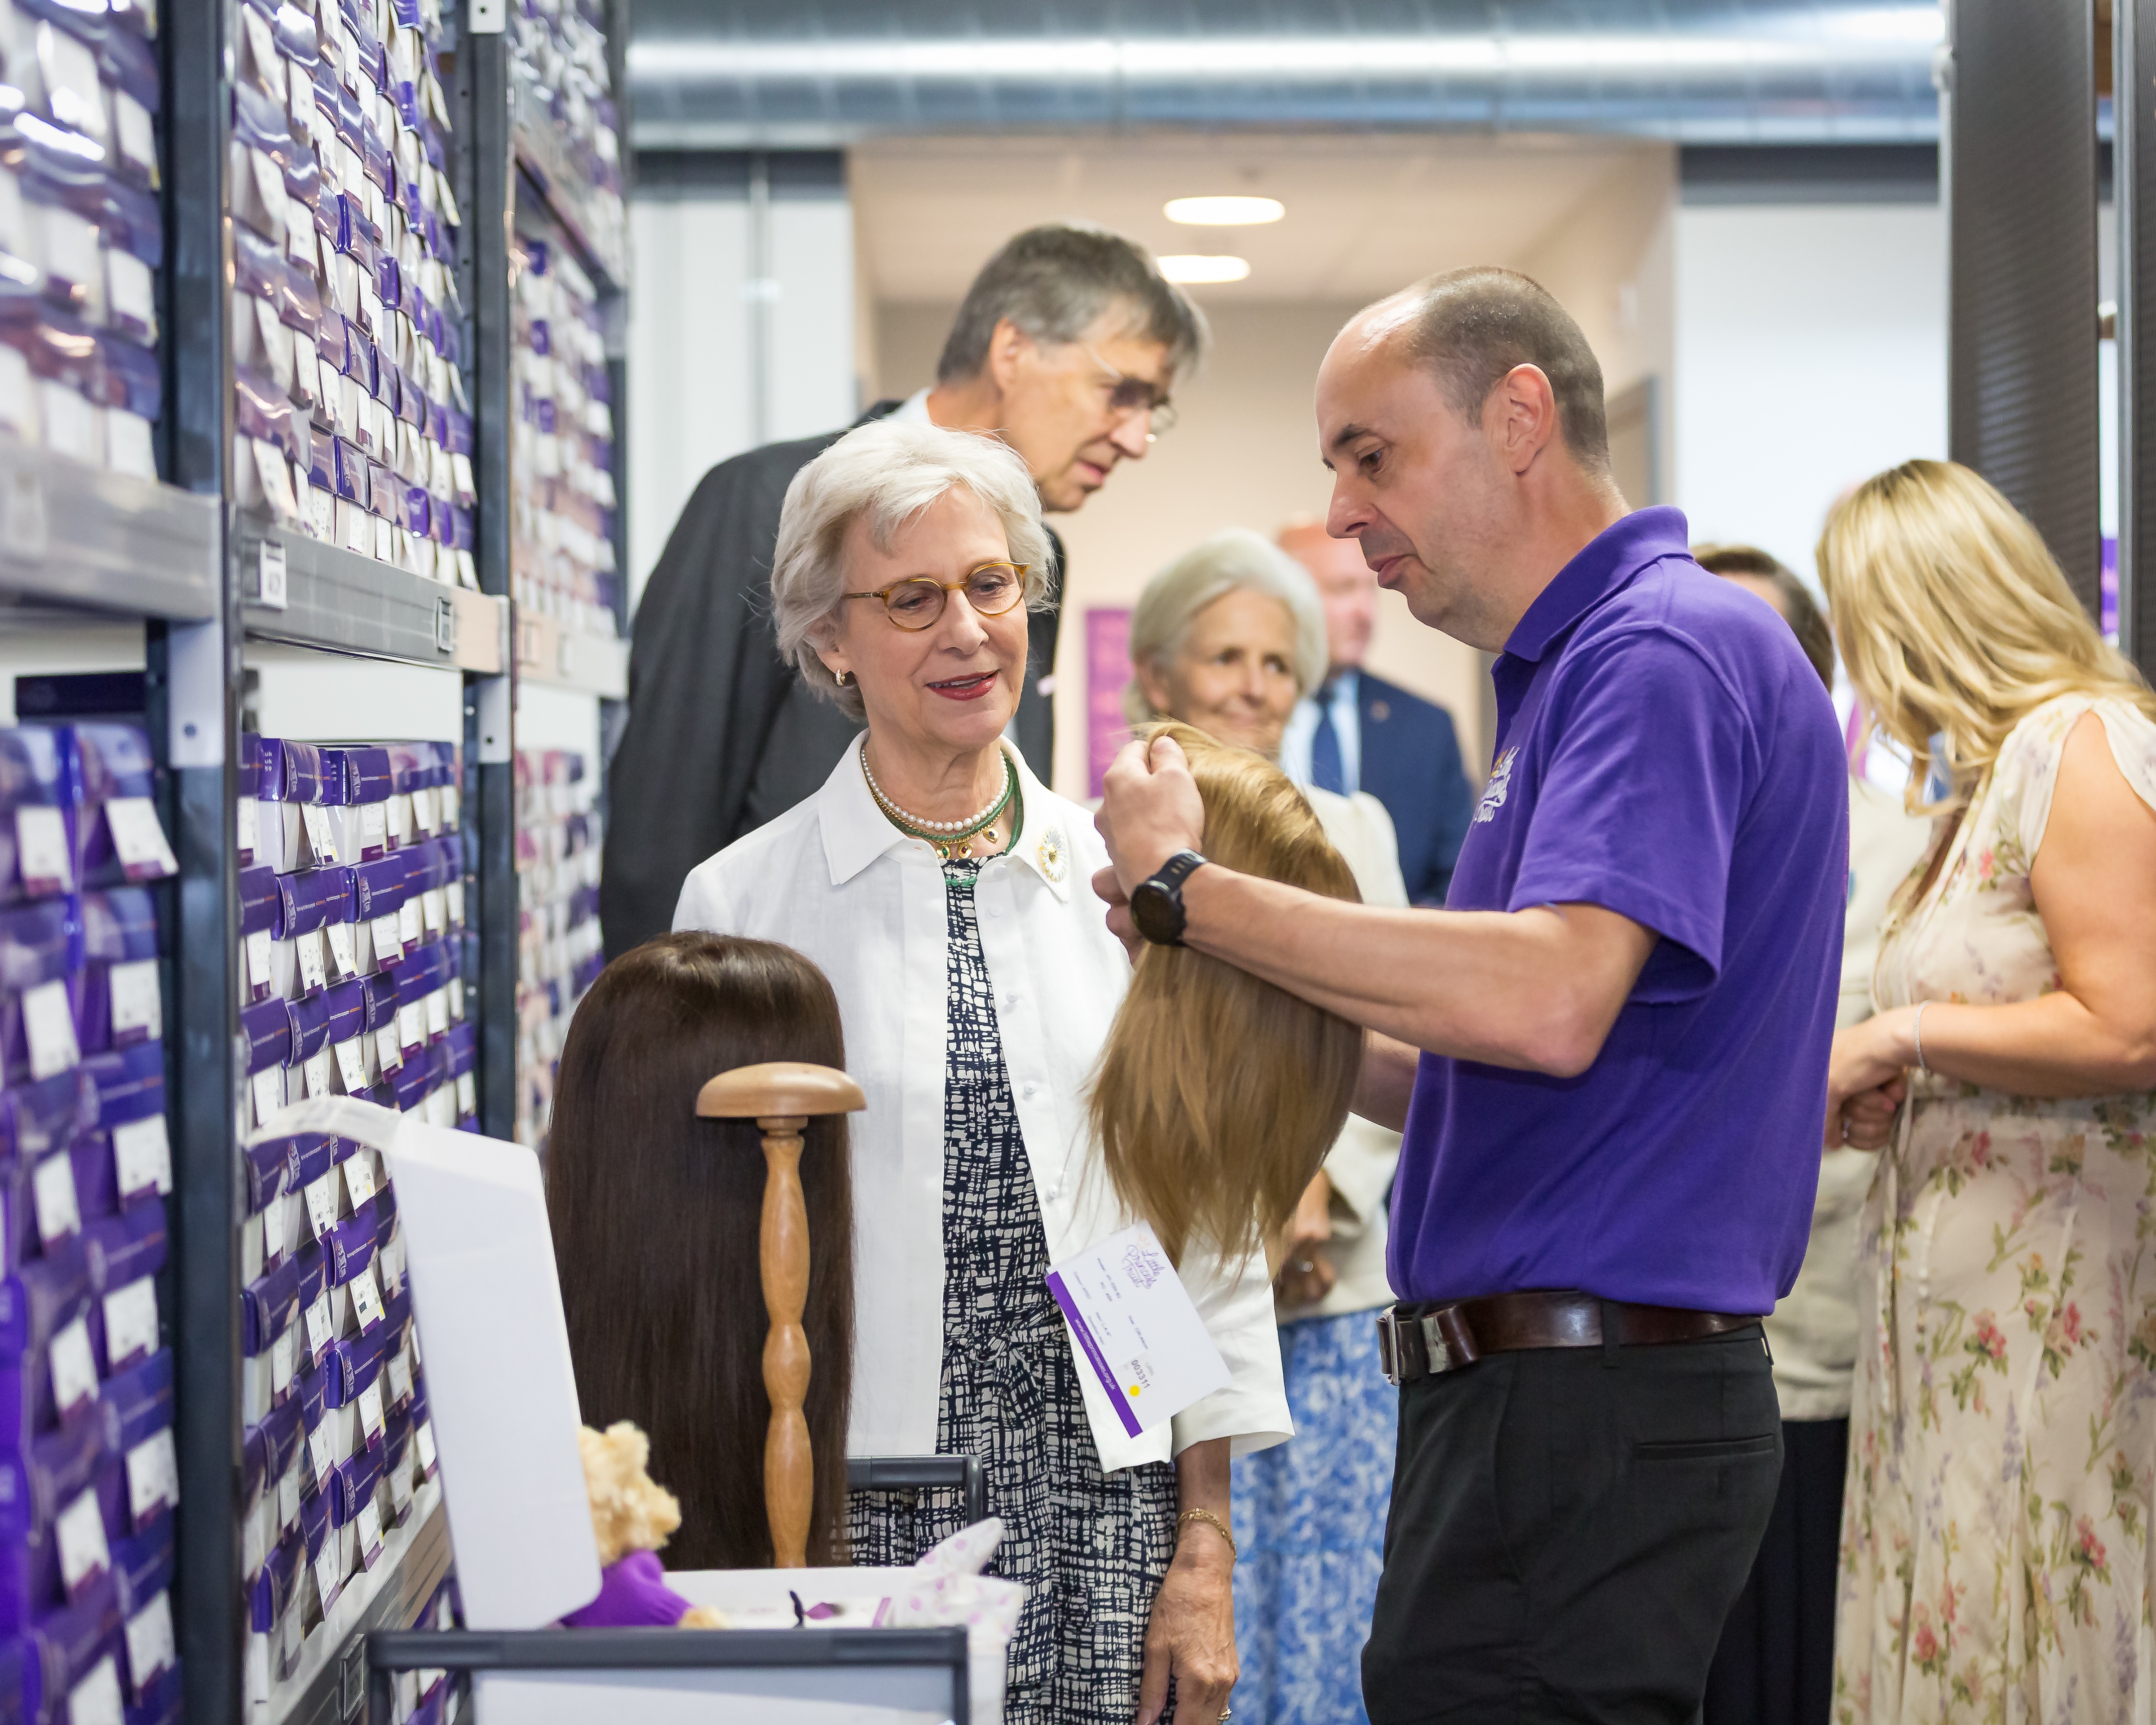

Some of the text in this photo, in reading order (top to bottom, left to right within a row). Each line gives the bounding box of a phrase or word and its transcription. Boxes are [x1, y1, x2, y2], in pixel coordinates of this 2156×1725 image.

[1122, 1255, 1145, 1287] Trust
[1127, 1245, 1157, 1289] Princess
[1140, 1250, 1165, 1278] Little
[1131, 1359, 1151, 1389] 003311
